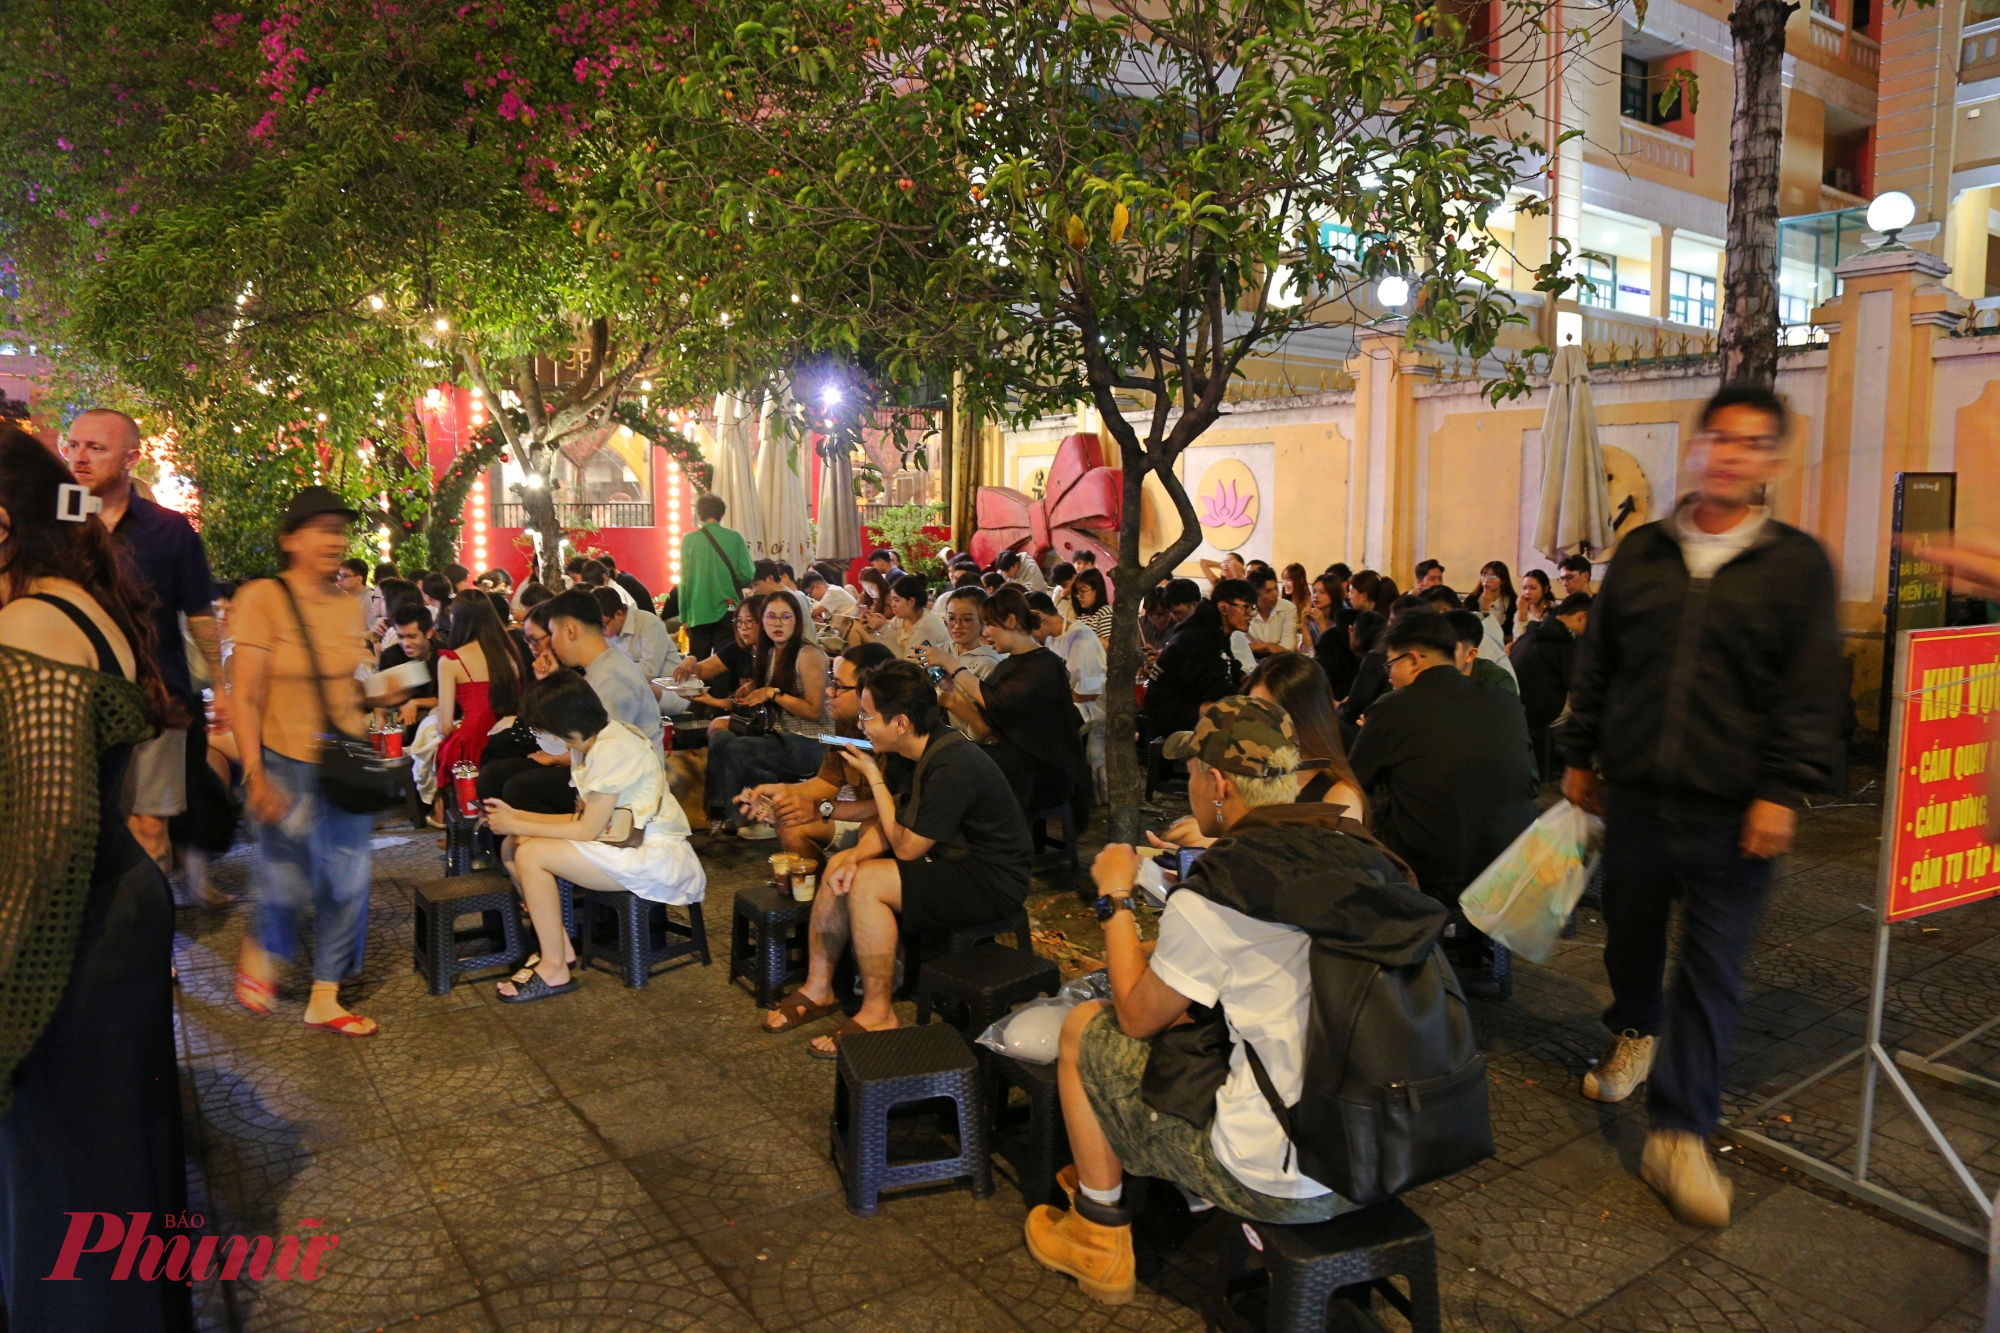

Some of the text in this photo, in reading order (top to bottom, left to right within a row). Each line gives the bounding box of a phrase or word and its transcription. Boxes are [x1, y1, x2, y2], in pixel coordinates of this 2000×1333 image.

[1920, 666, 1964, 722] KHU
[1919, 739, 1952, 784] CẤM
[1954, 742, 1989, 780] QUAY
[1915, 794, 1948, 839] CẤM
[1910, 848, 1943, 893] CẤM
[1945, 852, 1964, 889] TỤ
[1966, 842, 1991, 883] TẬP
